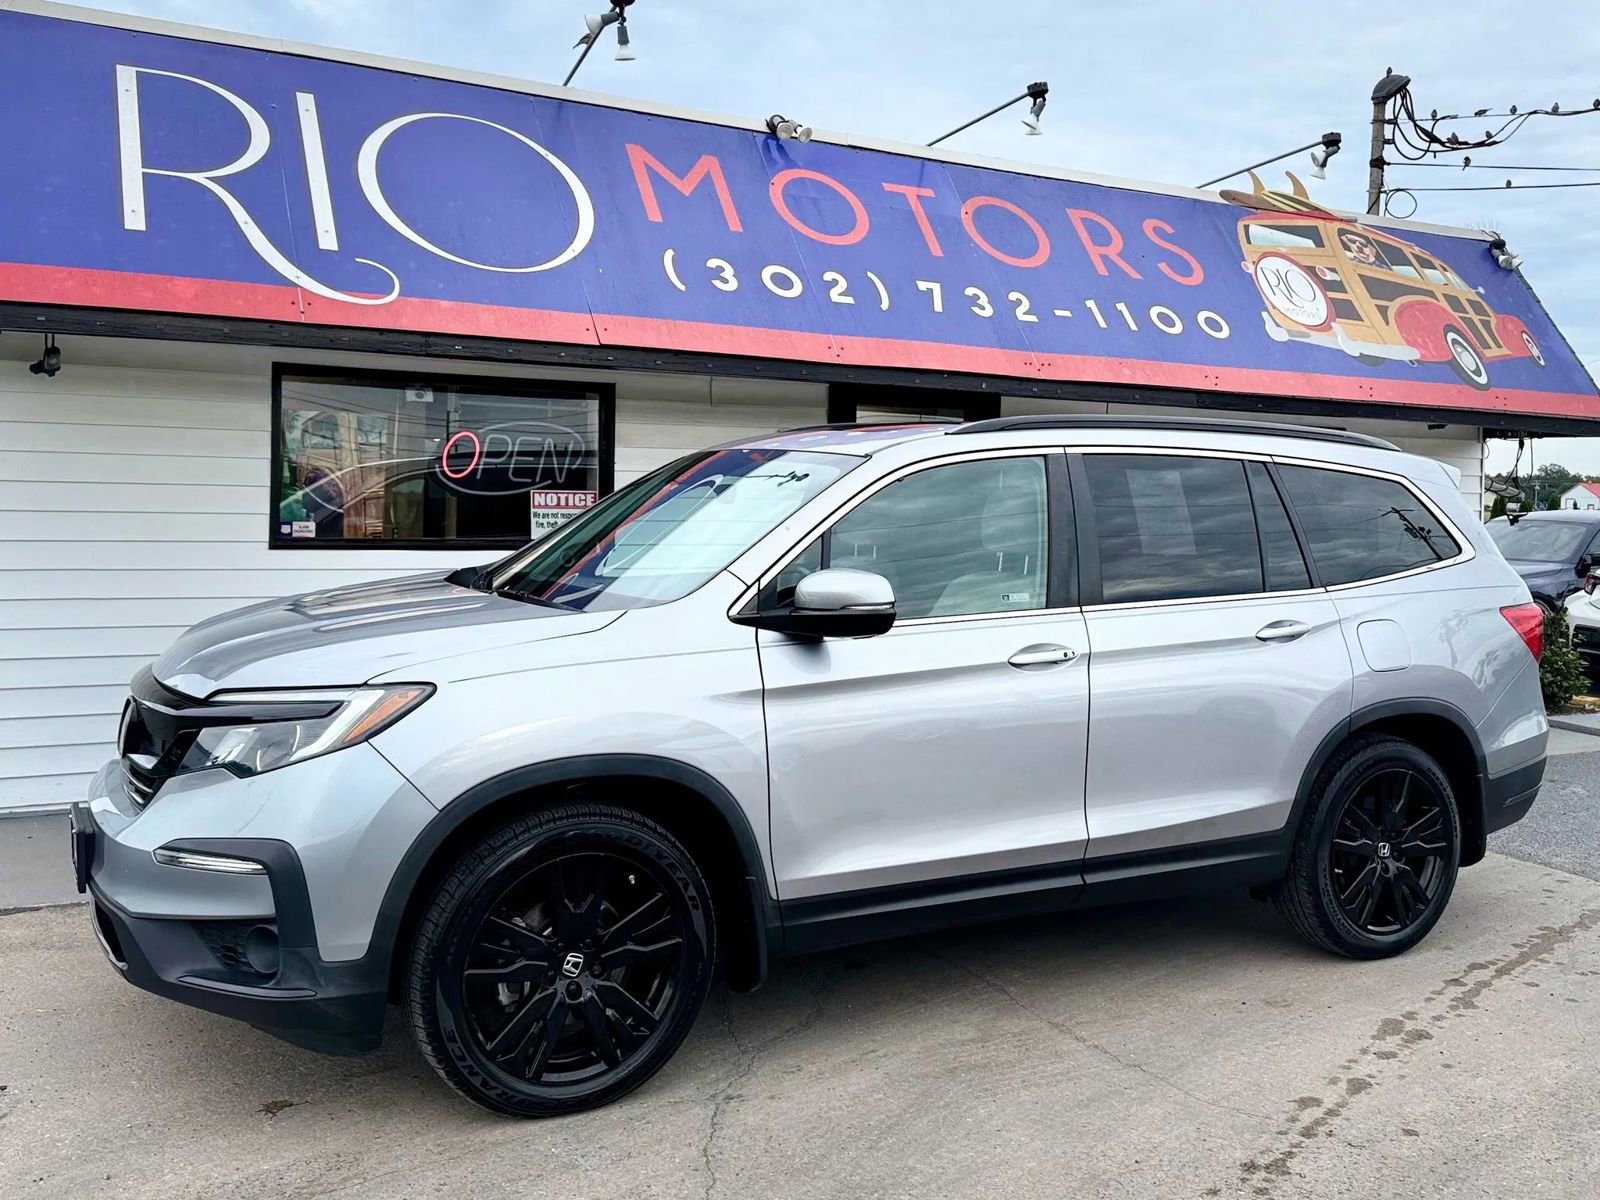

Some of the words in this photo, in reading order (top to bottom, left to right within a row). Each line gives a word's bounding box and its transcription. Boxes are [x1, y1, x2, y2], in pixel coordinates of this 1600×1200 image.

[115, 64, 594, 305] RIO
[624, 143, 1204, 286] MOTORS
[663, 248, 890, 312] (302)
[915, 279, 1231, 339] 732-1100
[1260, 267, 1316, 308] RIO
[442, 430, 575, 484] OPEN
[534, 493, 595, 506] NOTICE
